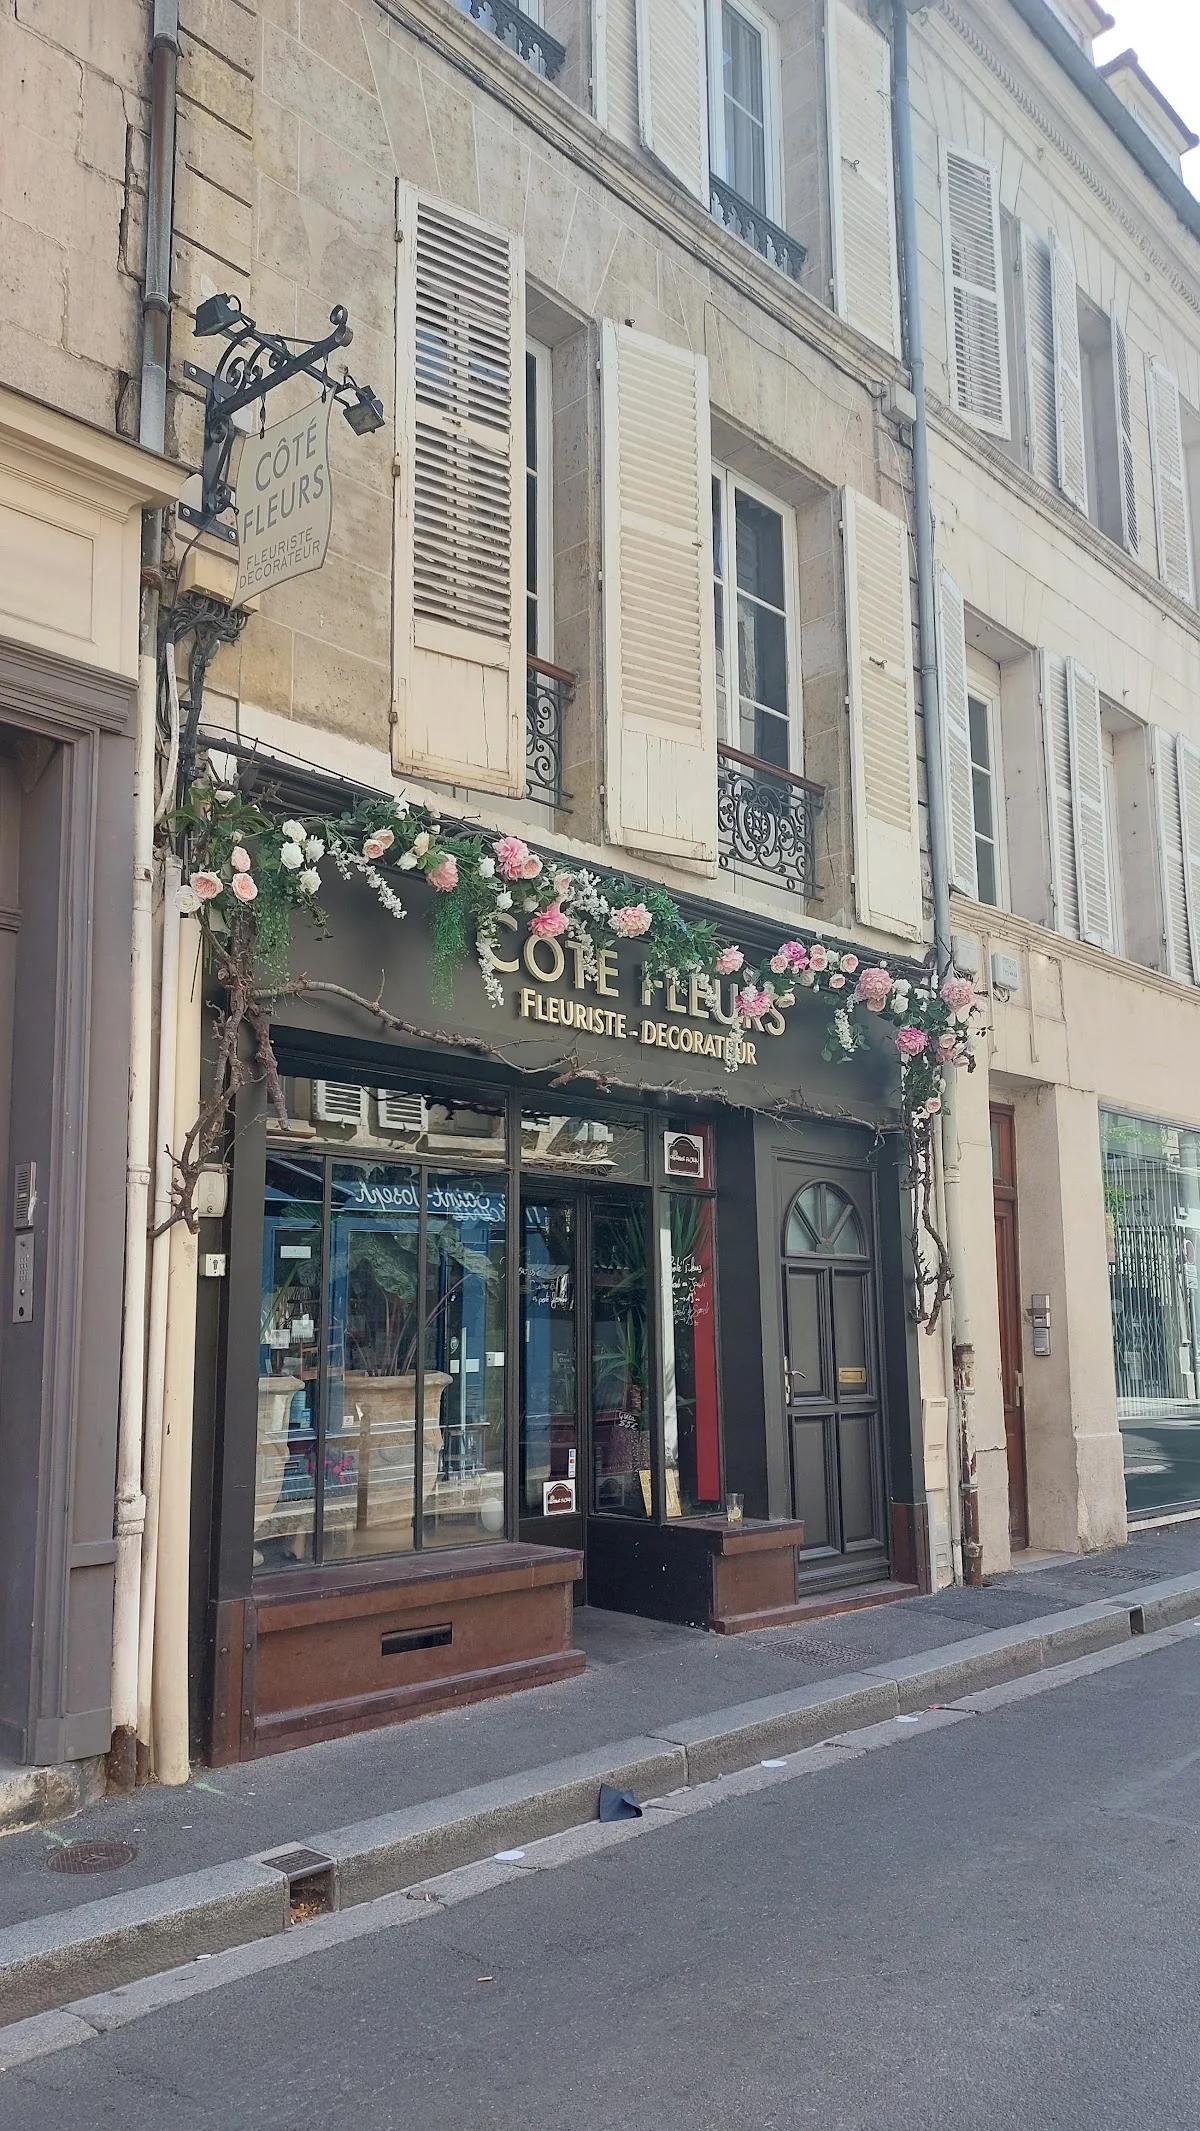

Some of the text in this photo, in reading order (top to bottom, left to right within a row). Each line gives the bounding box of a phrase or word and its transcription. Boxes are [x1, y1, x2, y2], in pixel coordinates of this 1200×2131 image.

[256, 416, 317, 492] CÔTÉ
[243, 464, 324, 544] FLEURS
[240, 540, 320, 588] DECORATEUR
[247, 527, 313, 570] FLEURISTE
[641, 961, 786, 1036] FLEUS
